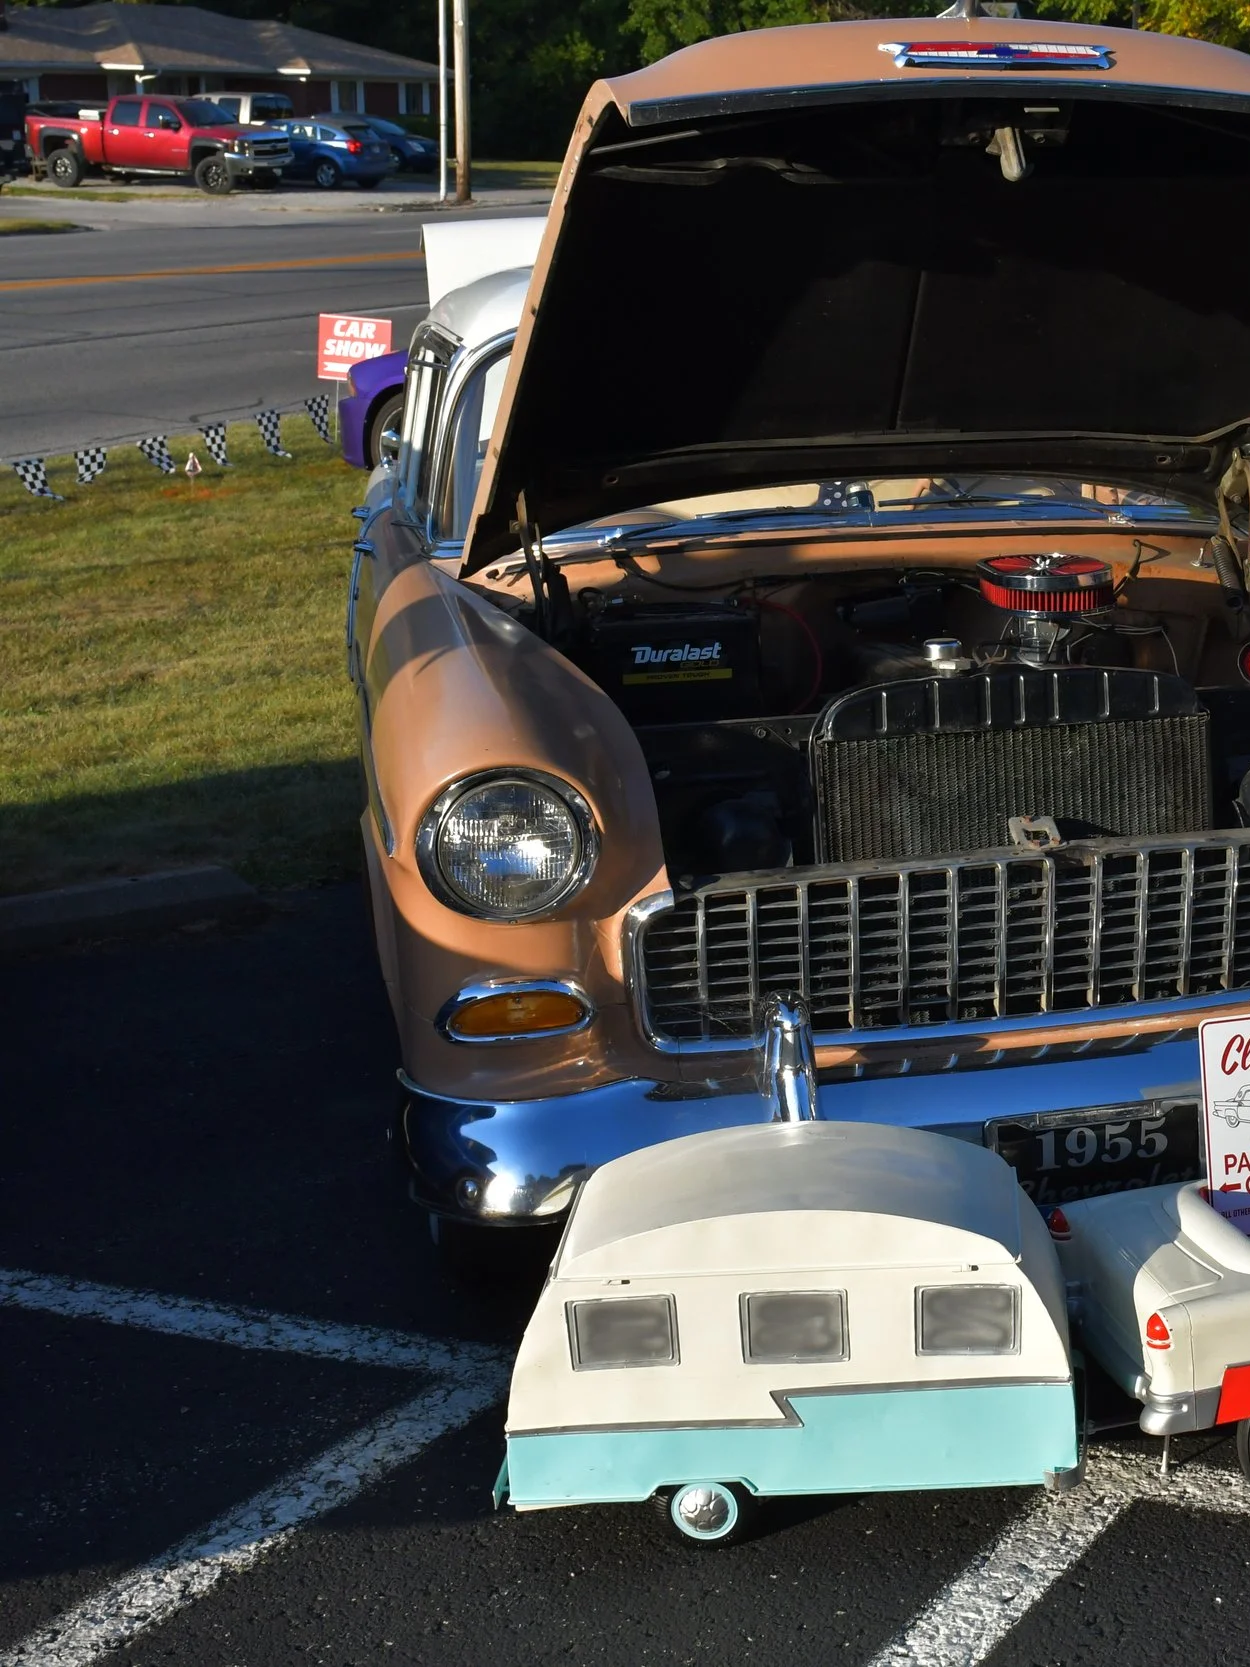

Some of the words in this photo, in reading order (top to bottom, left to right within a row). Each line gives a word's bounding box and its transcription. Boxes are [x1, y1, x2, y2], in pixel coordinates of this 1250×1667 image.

[333, 320, 376, 339] CAR
[323, 339, 386, 359] SHOW
[631, 642, 722, 664] Duralast
[1035, 1116, 1169, 1172] 1955
